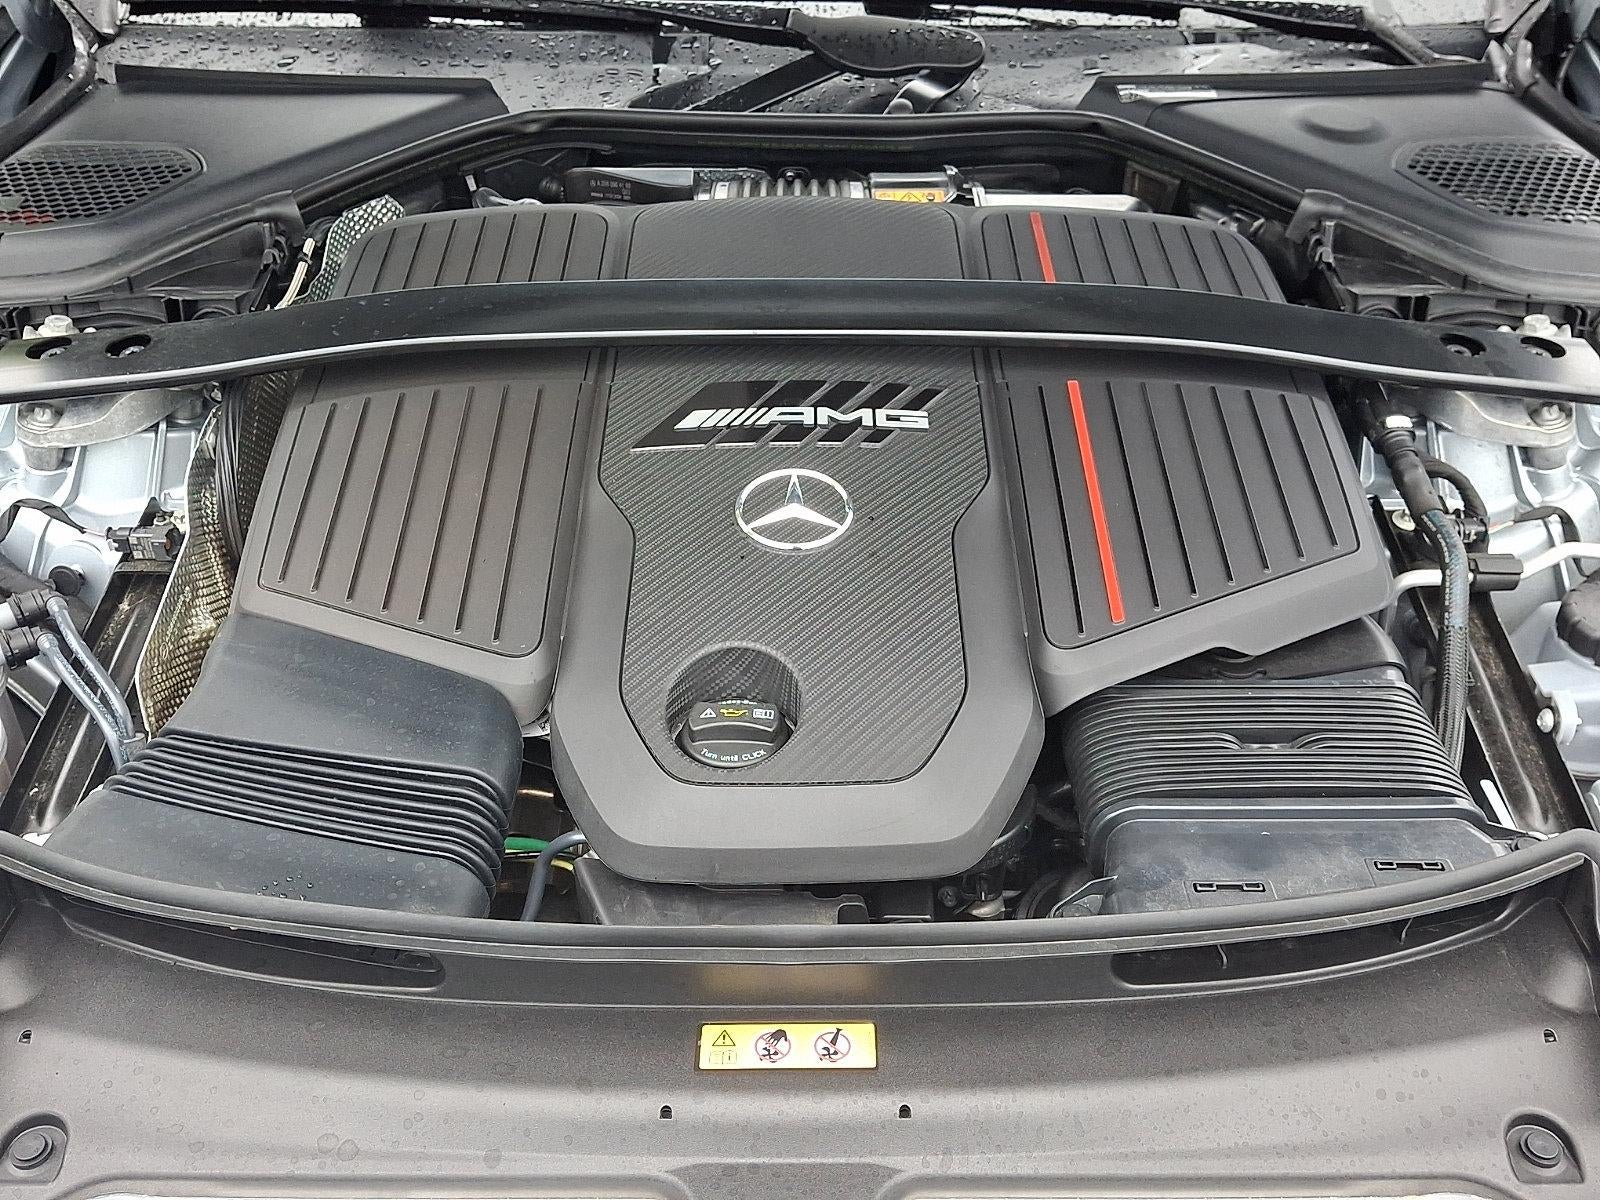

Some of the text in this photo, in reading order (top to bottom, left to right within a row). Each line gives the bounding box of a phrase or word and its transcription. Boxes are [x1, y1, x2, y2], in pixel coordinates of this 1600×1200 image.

[755, 406, 930, 431] AMG
[700, 747, 767, 762] Turn until CLICK
